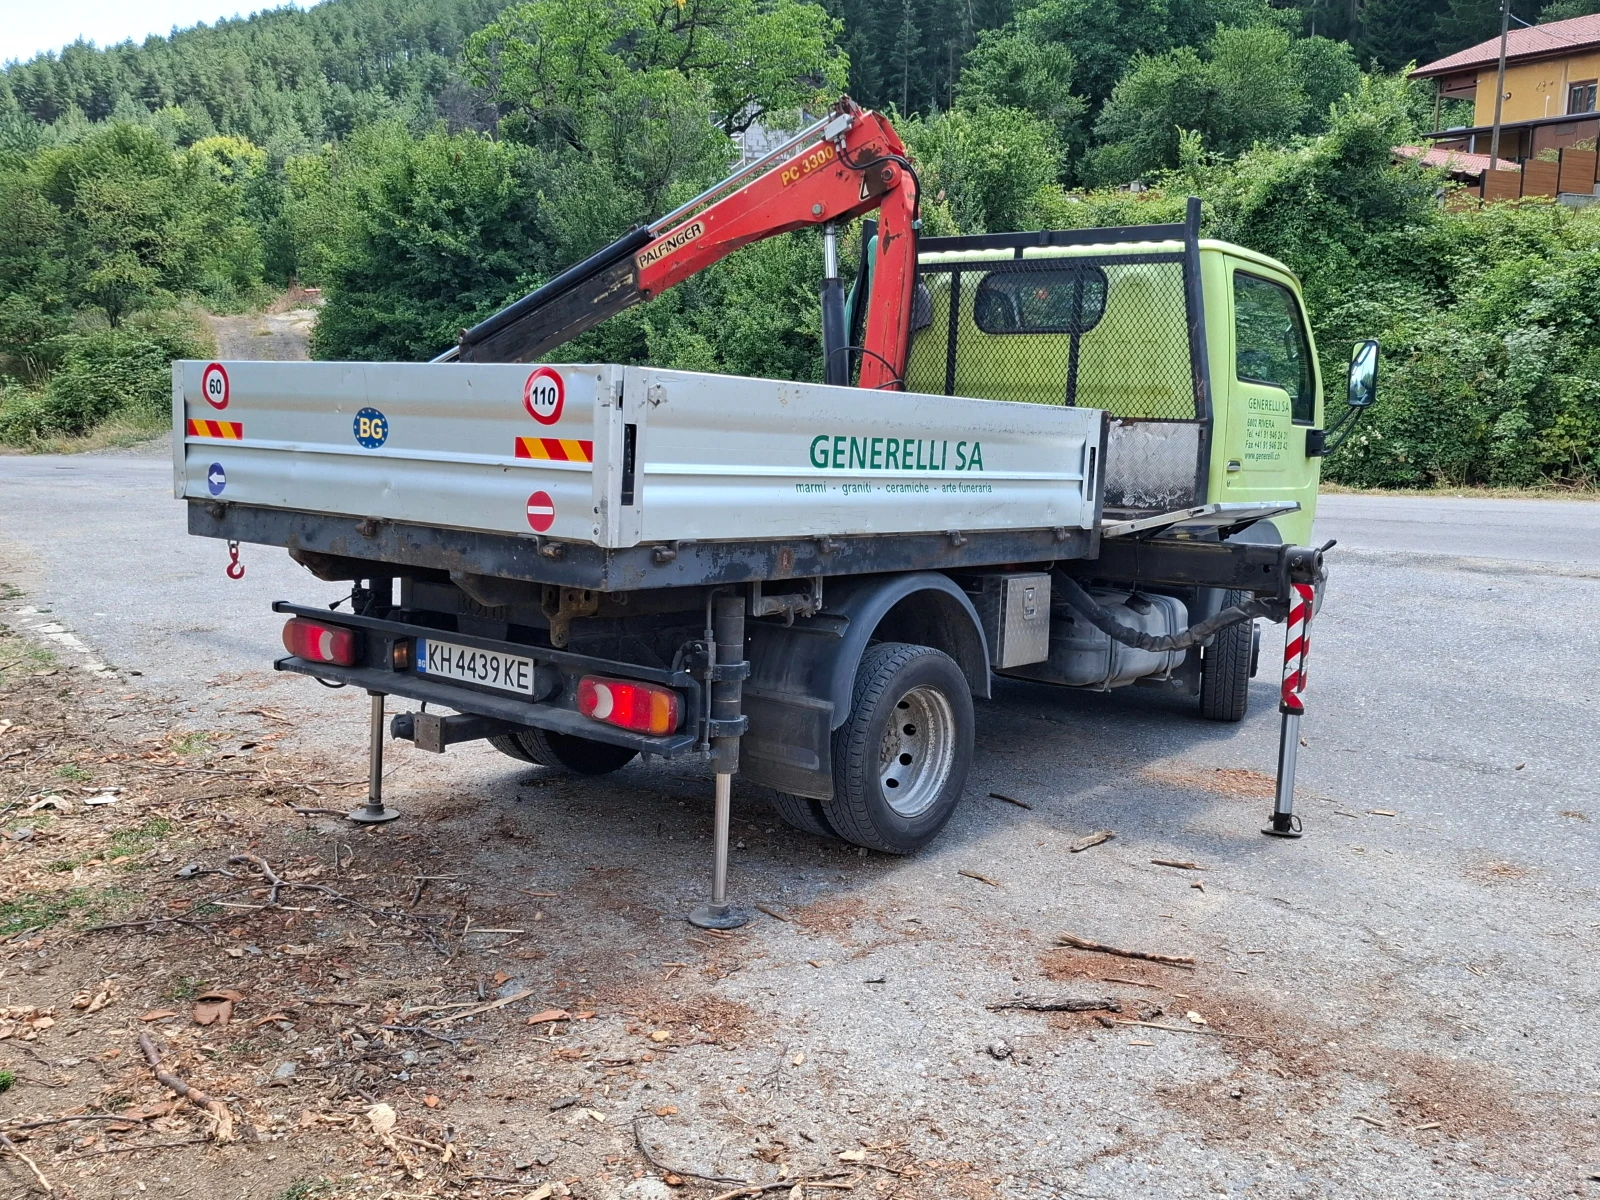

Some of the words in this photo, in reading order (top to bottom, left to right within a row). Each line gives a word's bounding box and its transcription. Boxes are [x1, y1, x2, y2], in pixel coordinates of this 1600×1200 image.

[780, 168, 800, 186] PC
[802, 145, 834, 173] 3300
[638, 223, 702, 268] PALFINGER
[209, 378, 222, 395] 60
[532, 386, 556, 406] 110
[1248, 397, 1280, 412] GENERELLI
[1281, 400, 1290, 413] SA
[359, 417, 383, 440] BG
[1258, 418, 1275, 429] RIVERA
[809, 434, 948, 471] GENERELLI
[954, 440, 984, 472] SA
[1244, 452, 1280, 462] www.generelli.ch
[795, 480, 827, 493] marmi
[841, 481, 872, 496] graniti
[885, 481, 929, 494] ceramiche
[941, 482, 957, 493] arte
[958, 481, 992, 493] funeraria
[418, 659, 426, 668] BG
